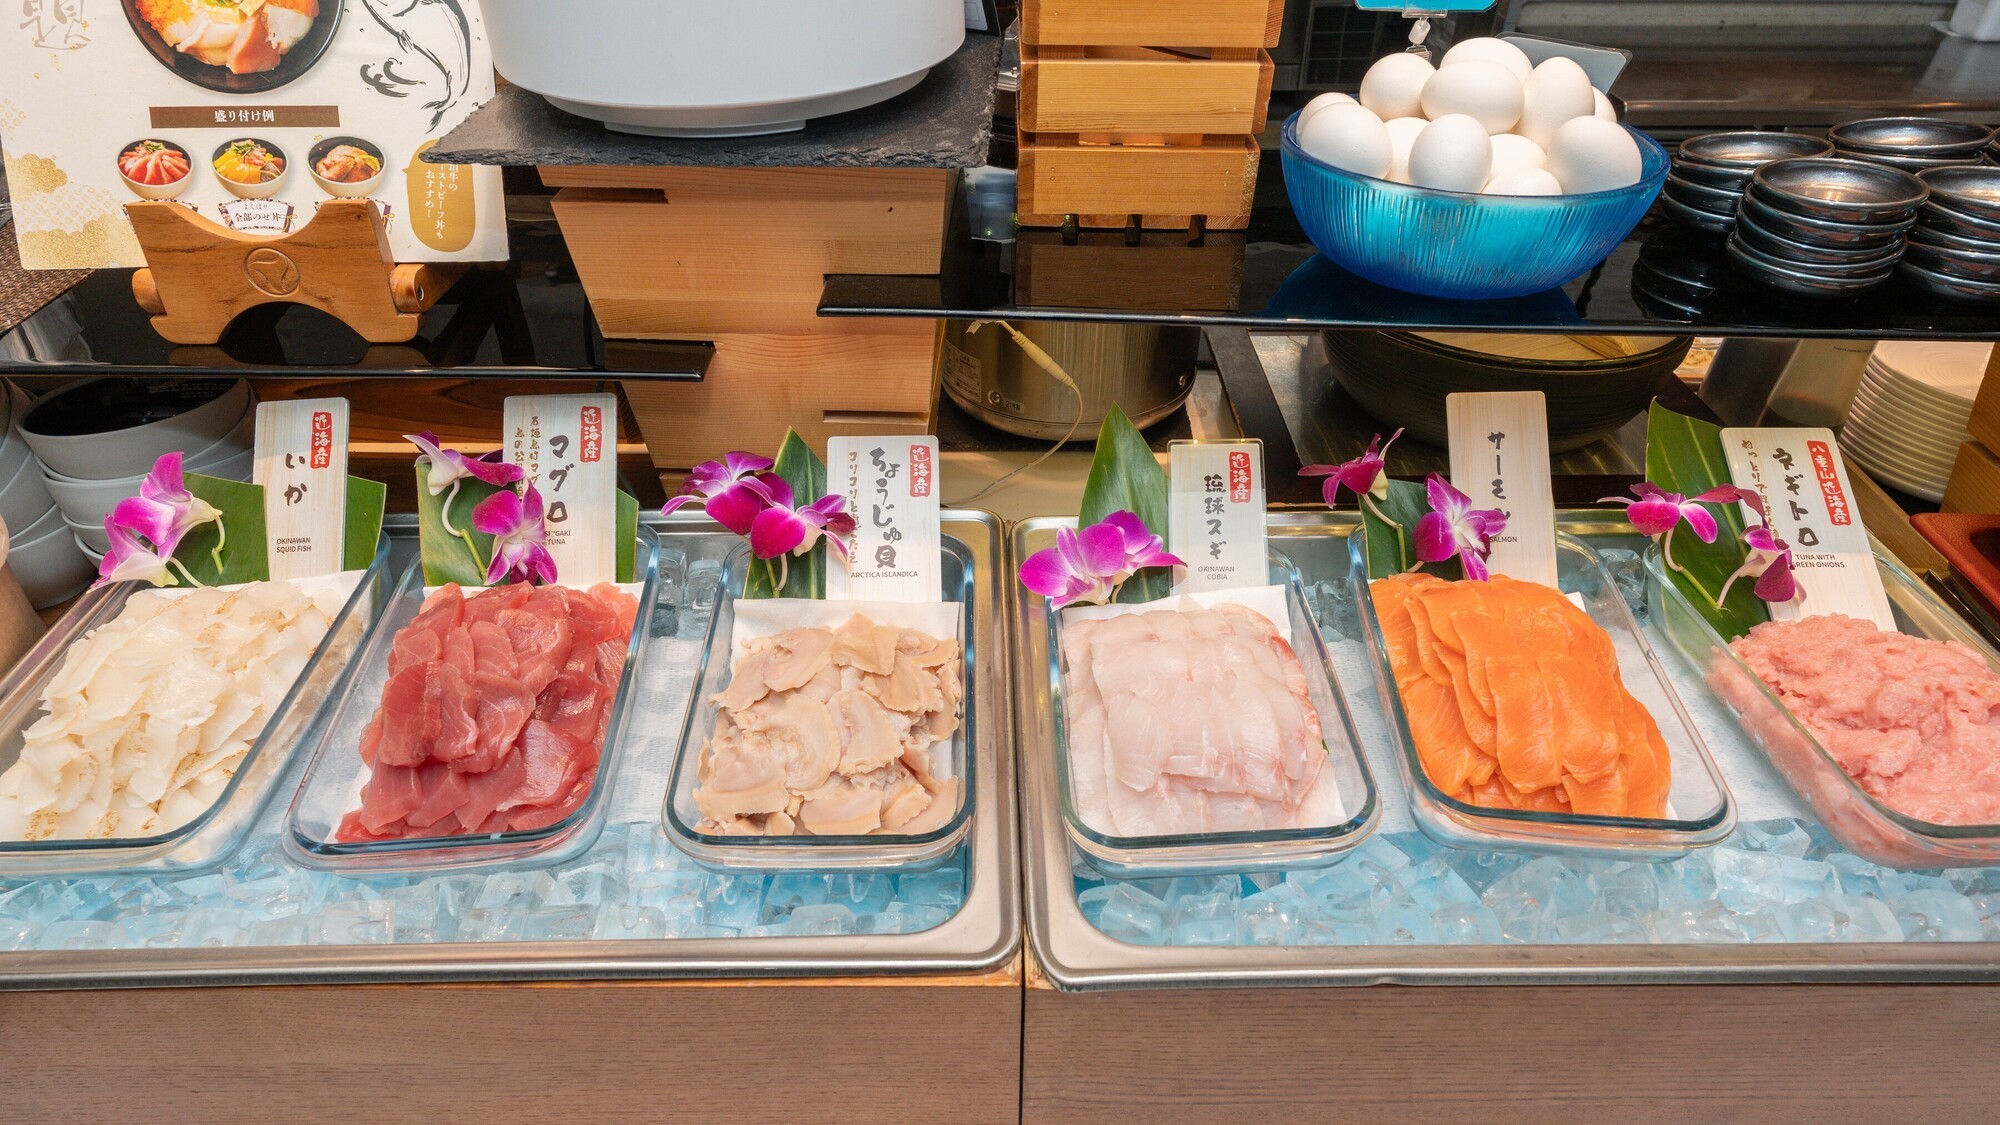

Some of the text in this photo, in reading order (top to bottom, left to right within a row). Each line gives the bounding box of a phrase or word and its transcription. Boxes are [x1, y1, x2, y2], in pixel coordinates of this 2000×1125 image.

[214, 110, 275, 123] 盛り付け例
[436, 164, 446, 239] ーストビーフ丼も
[448, 164, 458, 191] 垣牛の
[234, 212, 281, 222] 全部のせ丼
[313, 412, 331, 466] 近海産
[582, 408, 600, 459] 近海産
[284, 453, 307, 506] いか
[547, 434, 574, 523] マグロ
[912, 446, 930, 494] 近海産
[1231, 453, 1249, 500] 近海産
[1772, 447, 1819, 546] ネギトロ
[1811, 444, 1848, 523] 八重山近海産
[869, 447, 901, 568] ちょうじゅ貝
[1204, 474, 1227, 559] 琉球スギ
